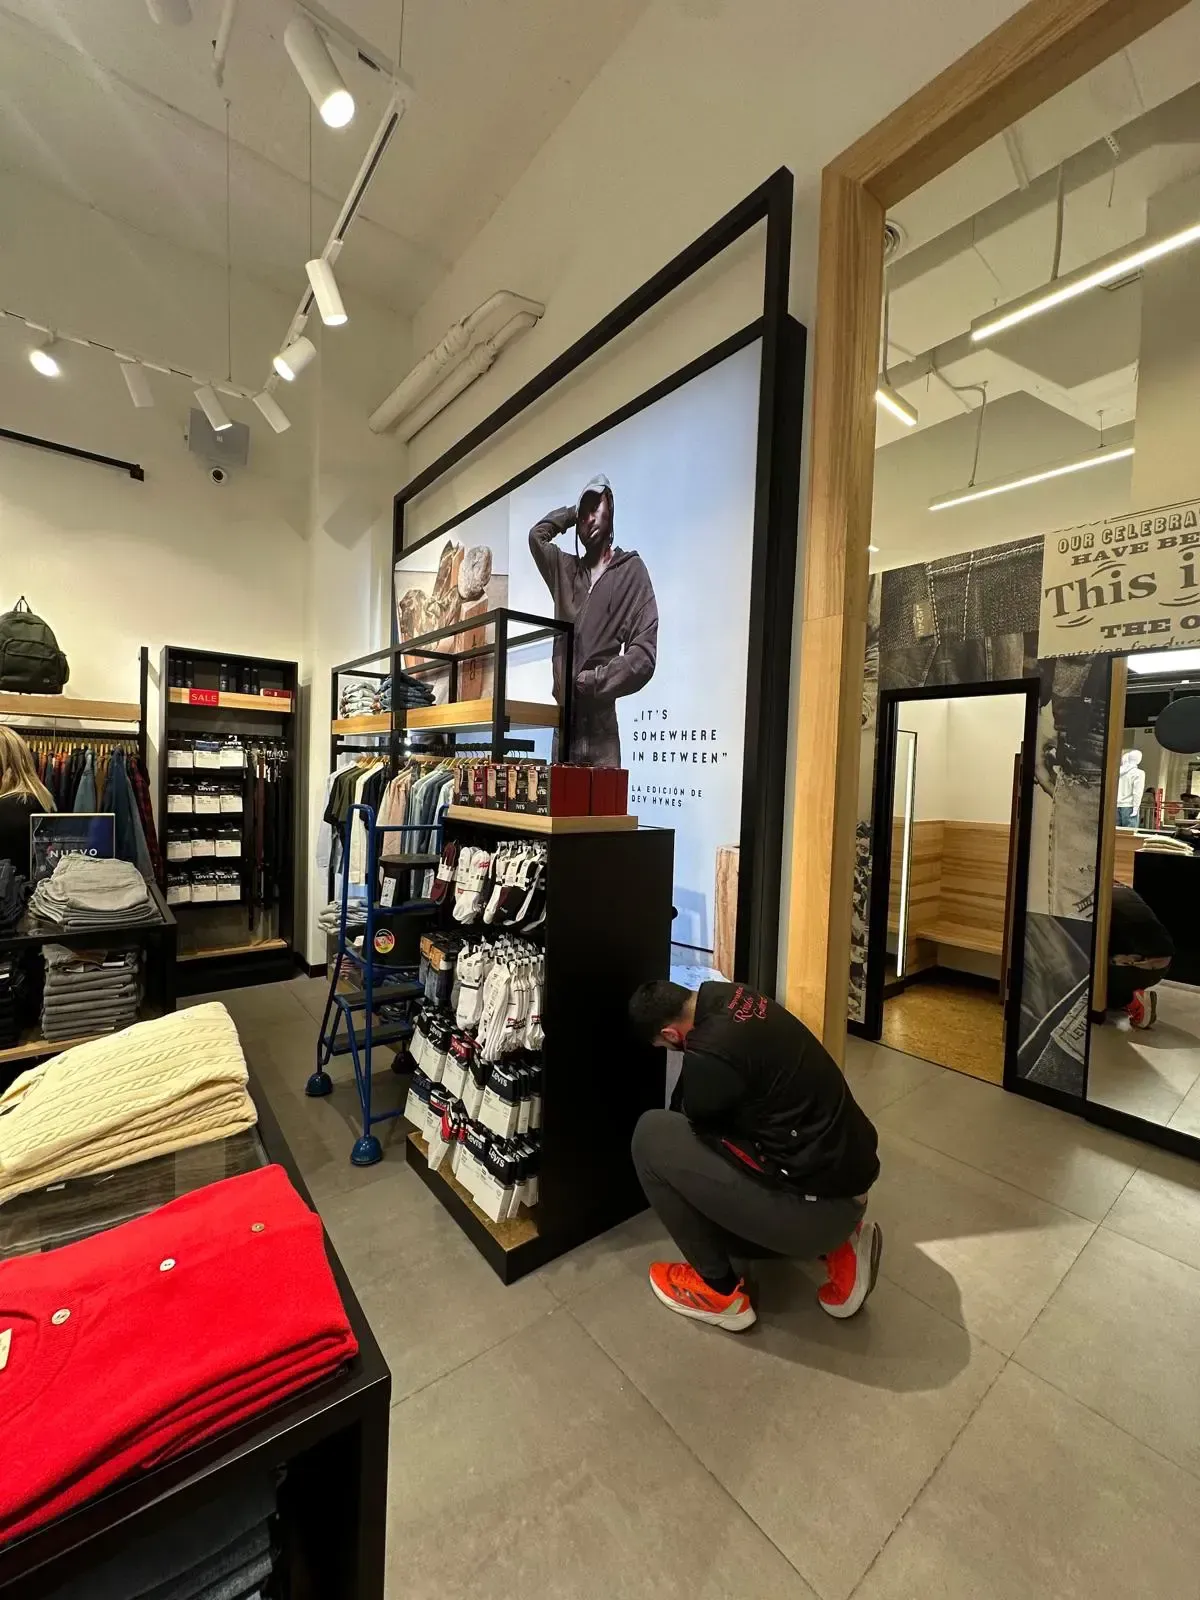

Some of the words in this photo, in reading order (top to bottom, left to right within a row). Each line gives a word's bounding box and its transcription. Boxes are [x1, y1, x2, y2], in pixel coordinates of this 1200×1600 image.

[1058, 533, 1094, 554] OUR
[1102, 508, 1200, 544] CELEBRA
[1071, 541, 1149, 566] HAVE
[1045, 570, 1157, 618] This
[1100, 618, 1171, 639] THE
[1180, 615, 1200, 630] O
[191, 693, 217, 703] SALE
[633, 729, 717, 741] SOMEWHERE
[632, 751, 644, 761] IN
[646, 785, 685, 796] EDICIÓN
[691, 789, 702, 798] DE
[631, 794, 647, 803] DEV
[652, 796, 682, 808] HYNES
